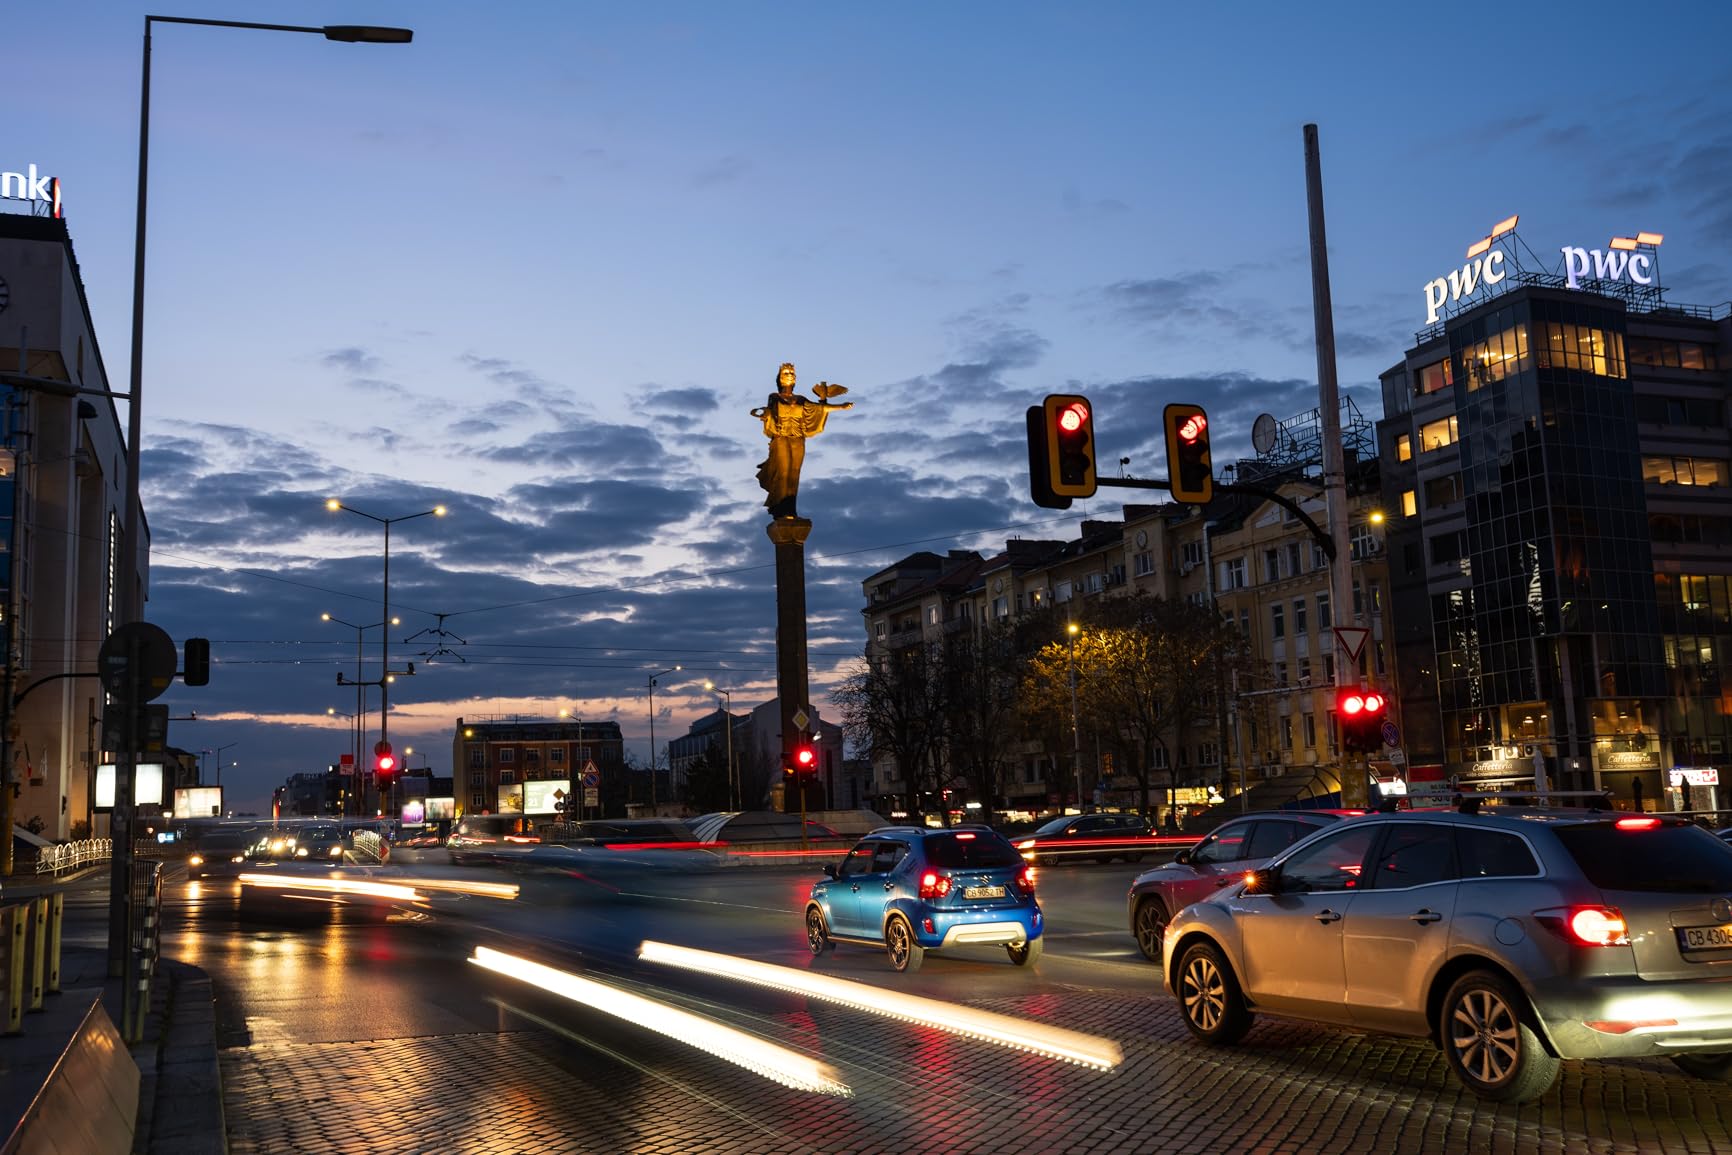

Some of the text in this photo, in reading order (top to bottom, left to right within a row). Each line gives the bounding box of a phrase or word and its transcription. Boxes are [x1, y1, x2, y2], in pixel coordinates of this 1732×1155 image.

[1560, 246, 1652, 290] pwc
[1424, 249, 1506, 325] pwc
[1607, 752, 1651, 764] Caffetteria
[1472, 761, 1513, 772] Caffetteria
[978, 889, 994, 897] 9052
[1687, 930, 1705, 946] CB
